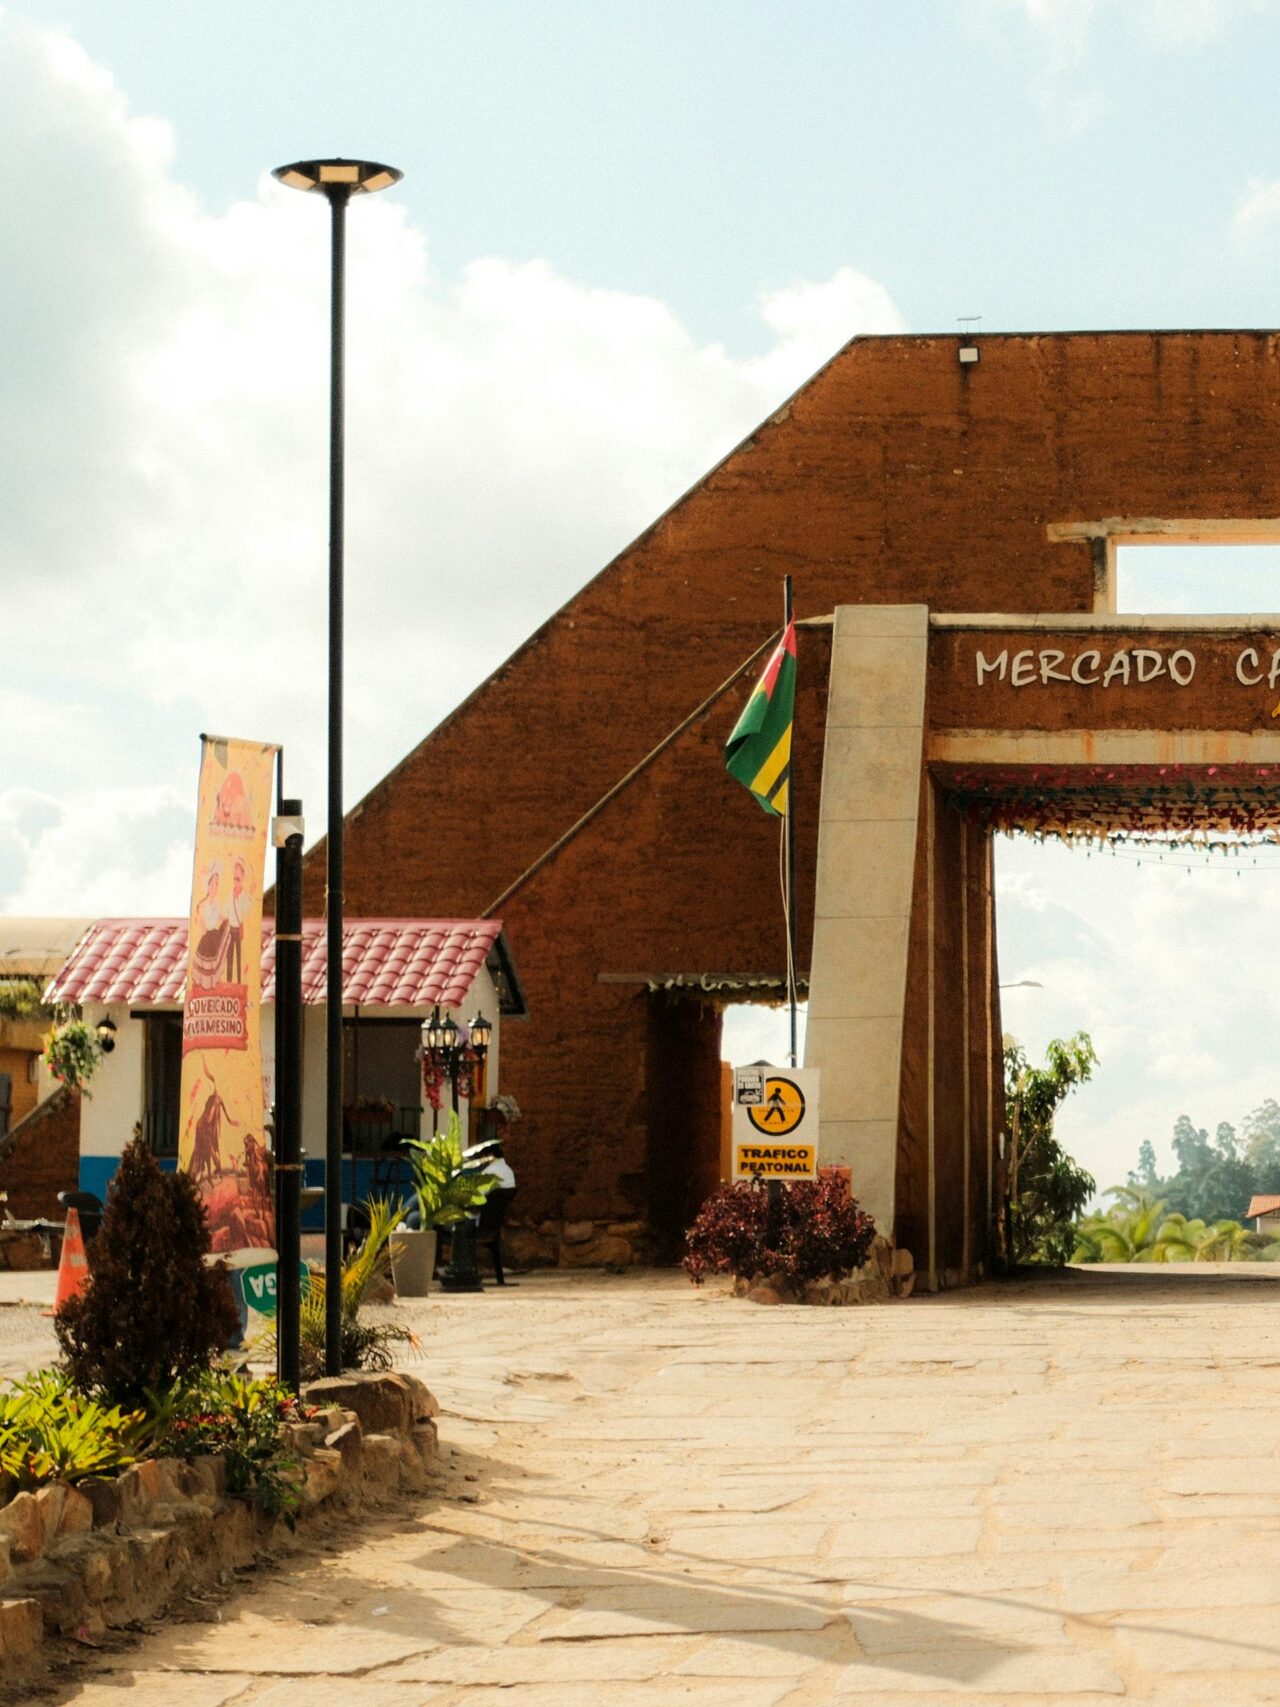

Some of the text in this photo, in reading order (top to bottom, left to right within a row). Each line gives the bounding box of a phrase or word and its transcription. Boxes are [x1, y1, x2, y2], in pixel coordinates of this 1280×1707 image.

[975, 649, 1197, 688] MERCADO
[741, 1149, 808, 1159] TRAFICO
[741, 1162, 810, 1172] PEATONAL
